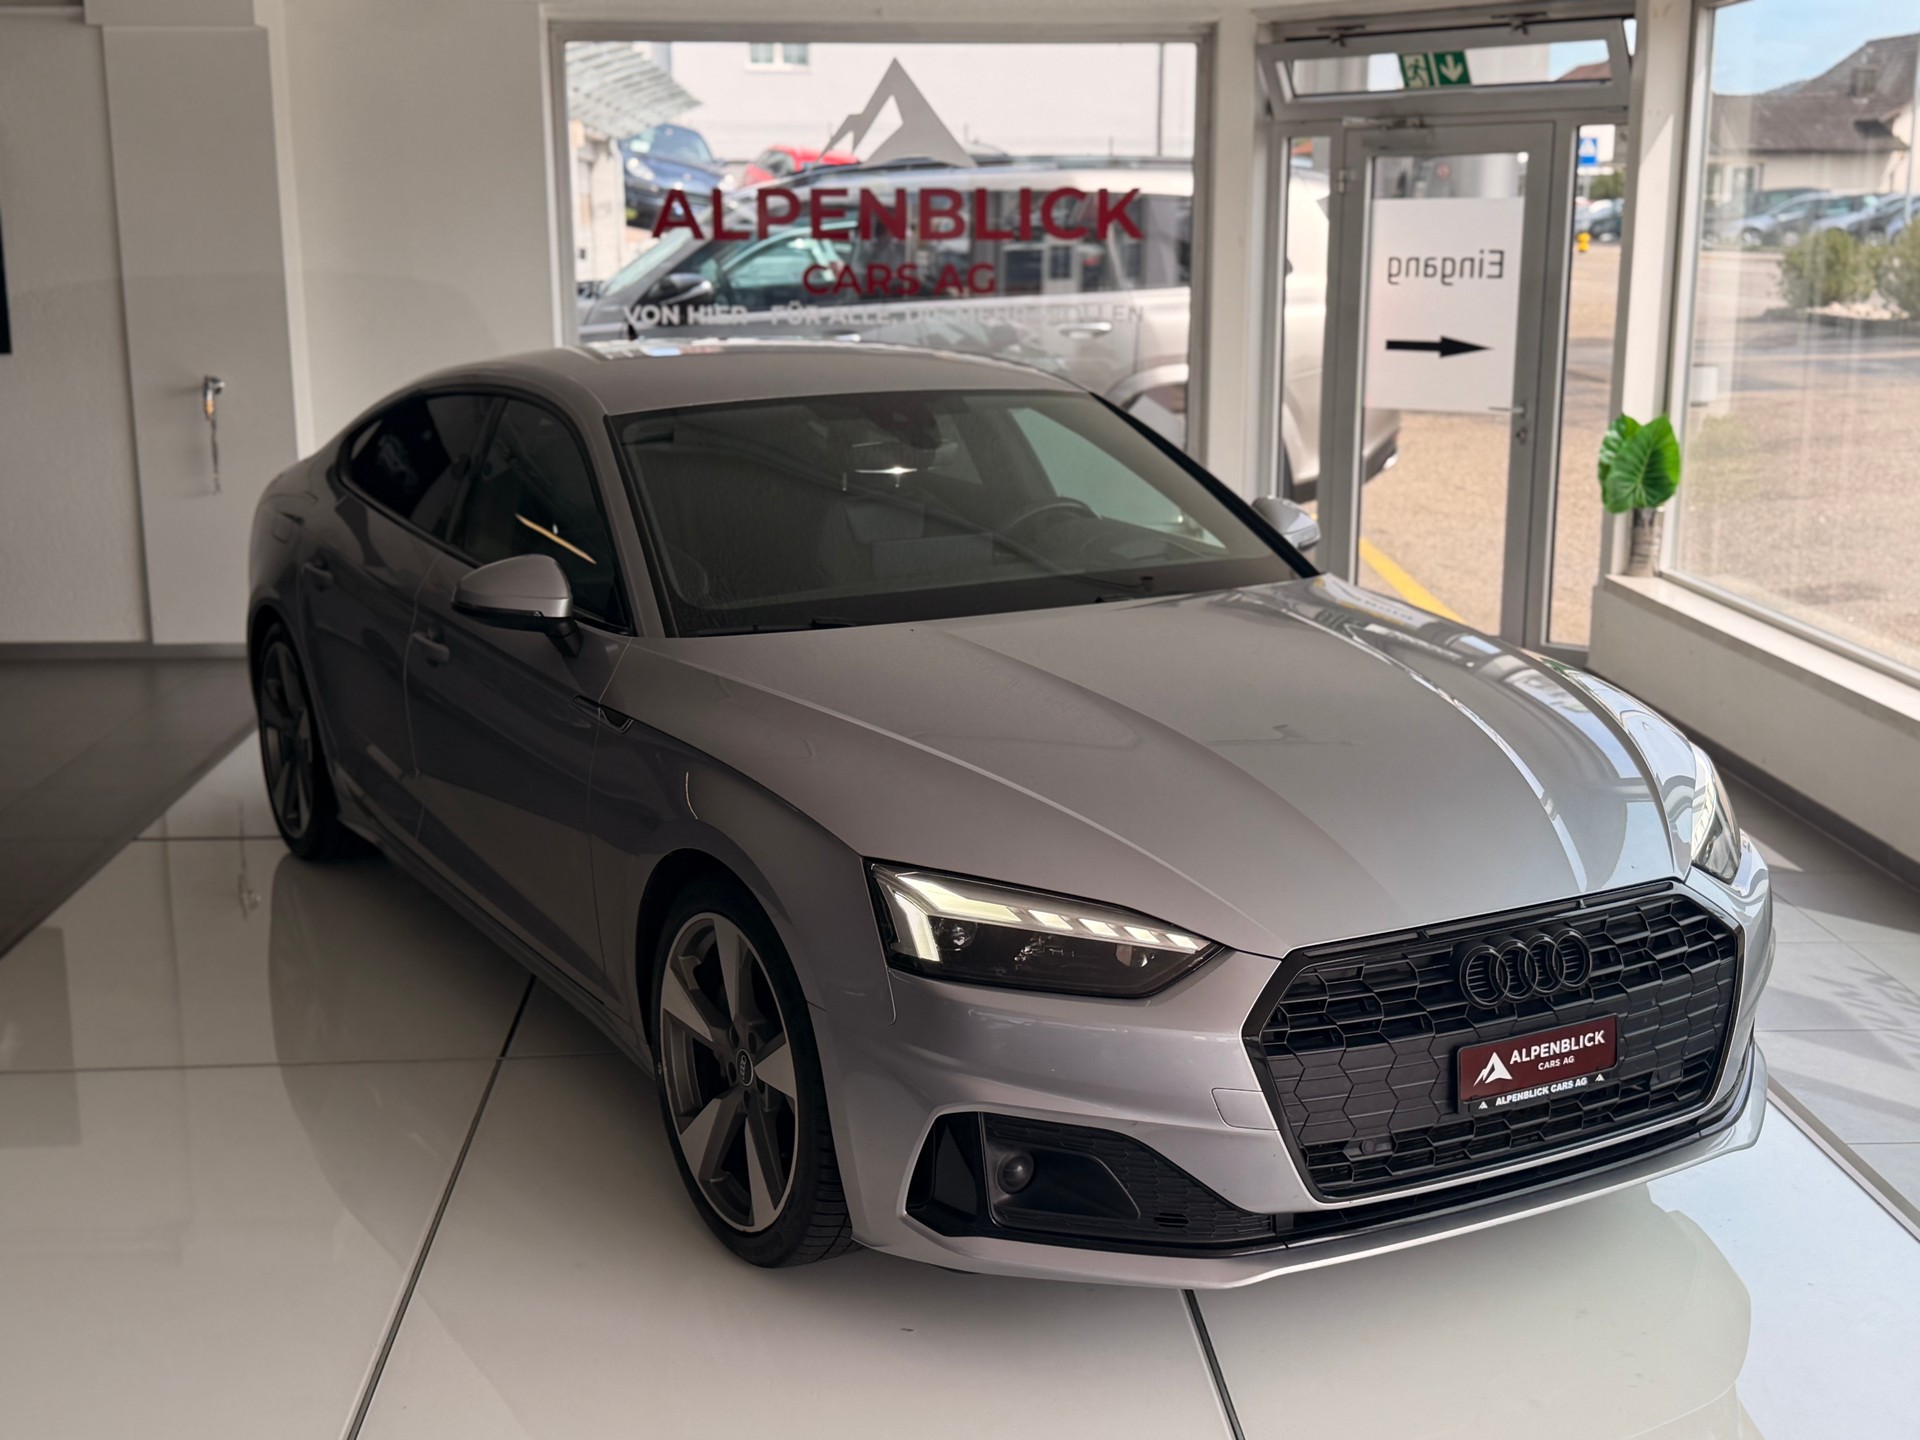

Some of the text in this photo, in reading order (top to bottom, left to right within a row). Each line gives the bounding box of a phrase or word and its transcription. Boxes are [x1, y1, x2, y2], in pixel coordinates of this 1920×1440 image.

[652, 186, 1144, 241] ALPENBLICK
[803, 263, 996, 296] CARS AG
[623, 304, 680, 325] VON
[687, 304, 748, 325] HIER
[770, 300, 821, 325] FÜR
[1509, 1030, 1606, 1065] ALPENBLICK
[1537, 1055, 1576, 1071] CARS AG
[1495, 1076, 1588, 1107] ALPENBLICK CARS AG
